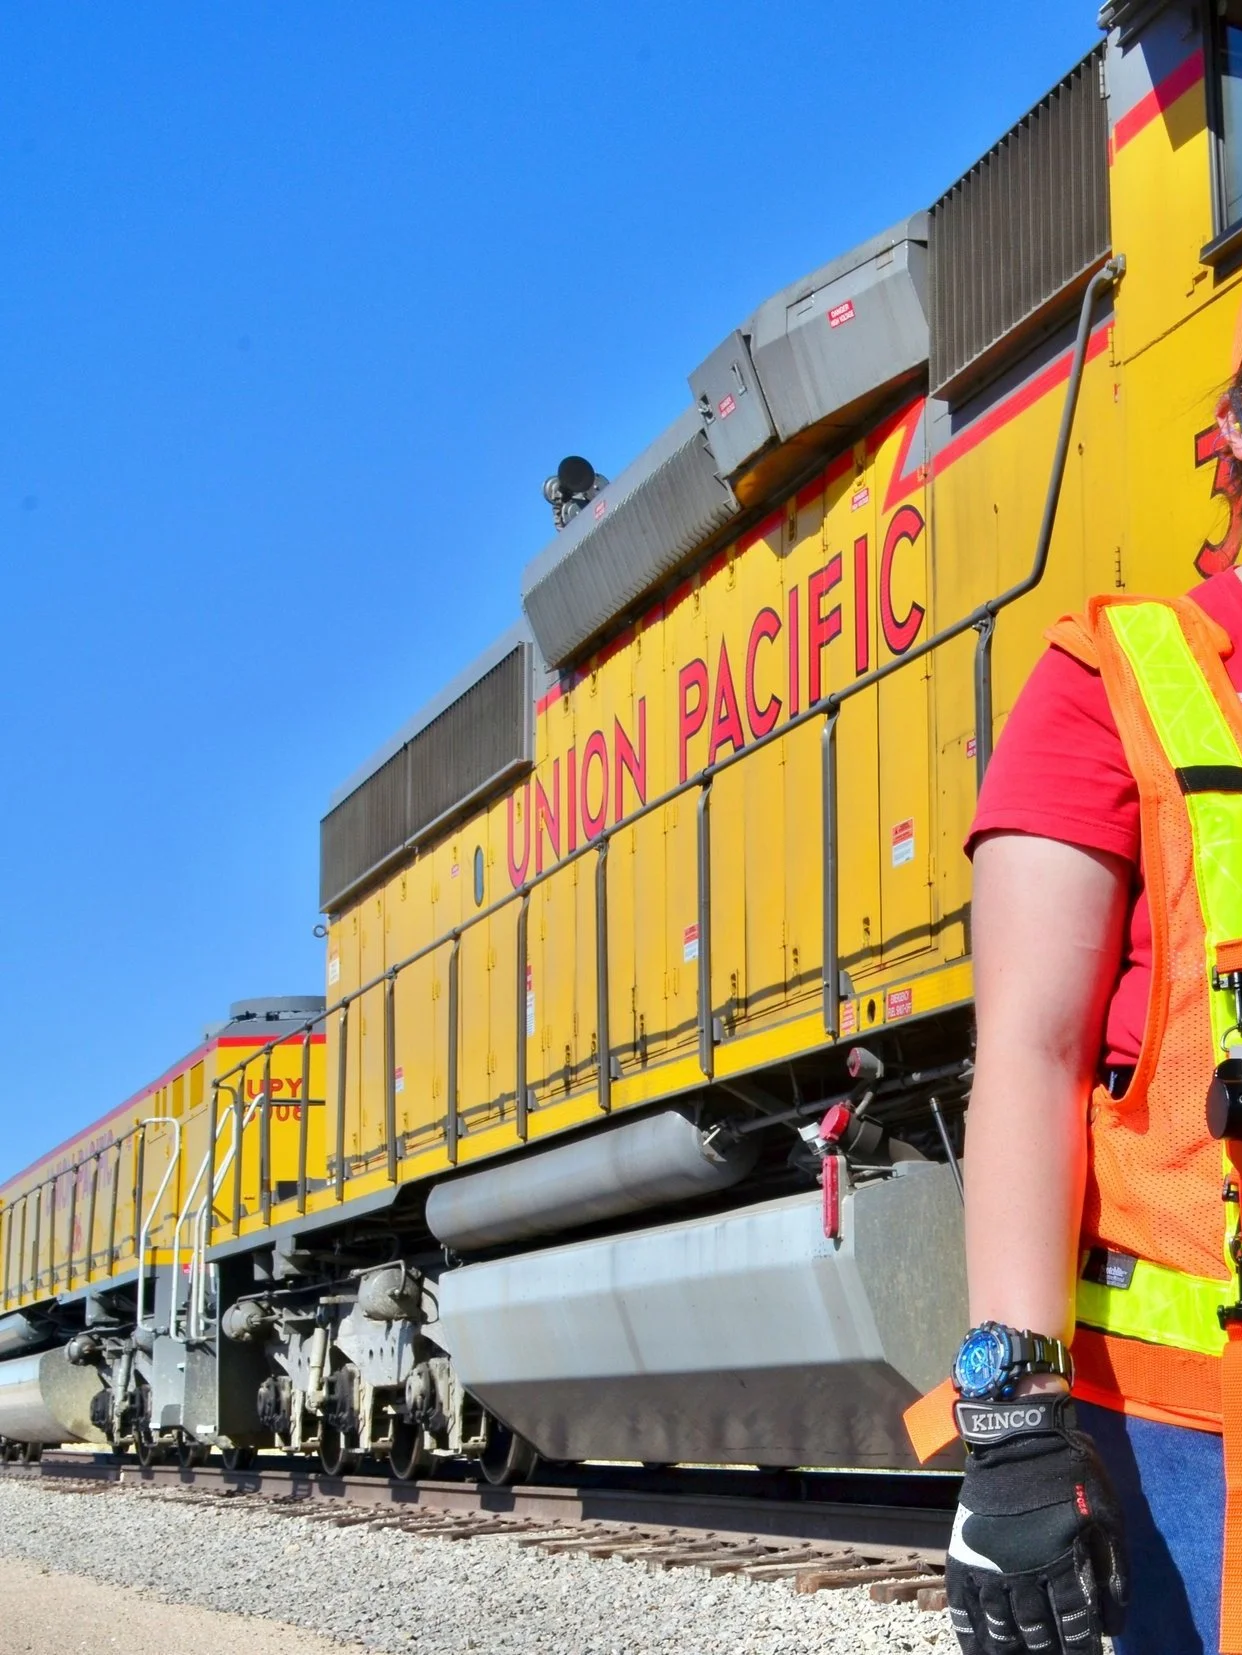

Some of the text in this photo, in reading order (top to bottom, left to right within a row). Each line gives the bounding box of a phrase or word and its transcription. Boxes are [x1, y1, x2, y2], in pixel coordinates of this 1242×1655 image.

[507, 504, 926, 891] UNION PACIFIC
[972, 1408, 1042, 1431] KINCO
